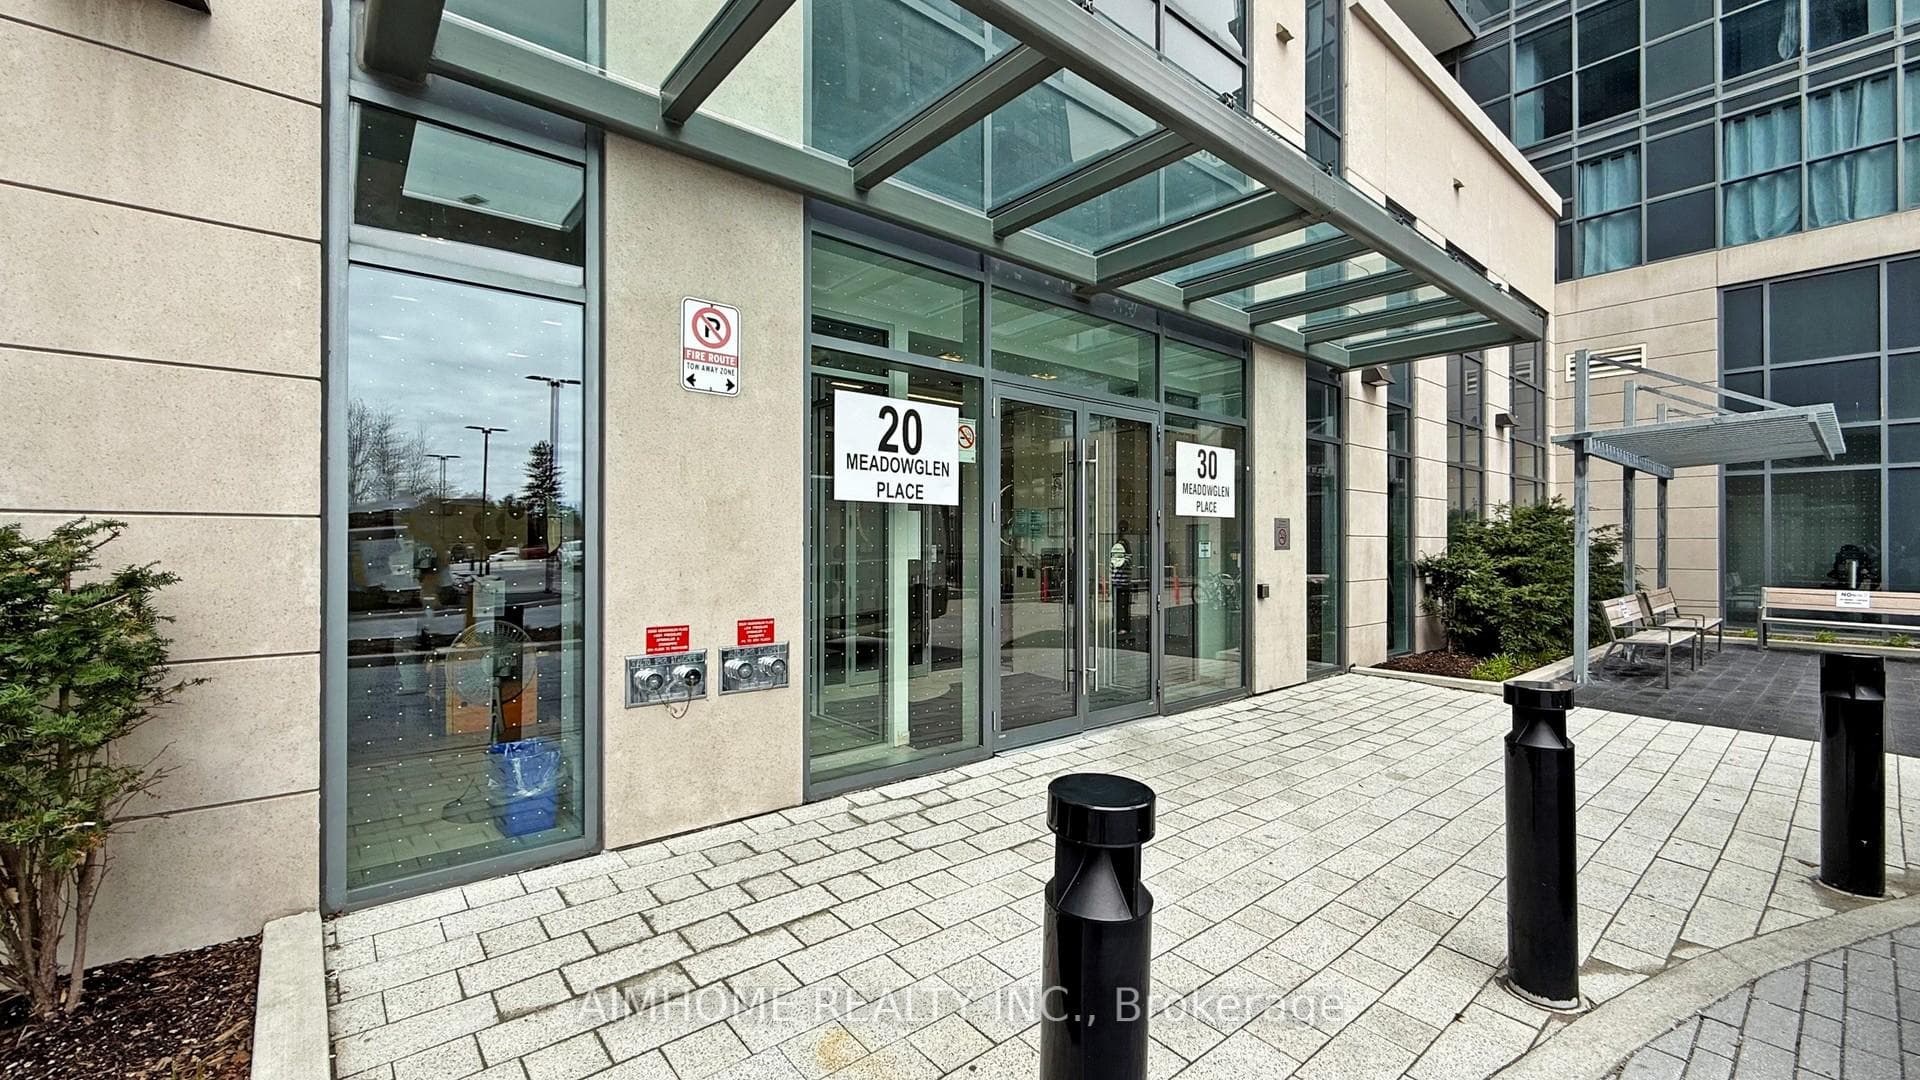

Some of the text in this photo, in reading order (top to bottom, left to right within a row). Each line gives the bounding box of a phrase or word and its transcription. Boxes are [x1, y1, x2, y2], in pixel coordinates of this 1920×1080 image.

[686, 349, 736, 365] FIRE ROUTE
[686, 362, 735, 376] TOW AWAY ZONE
[878, 405, 922, 455] 20
[846, 453, 950, 477] MEADOWGLEN
[1197, 449, 1218, 480] 30
[877, 482, 924, 500] PLACE
[1182, 482, 1230, 498] MEADOWGLEN
[1196, 501, 1218, 513] PLACE
